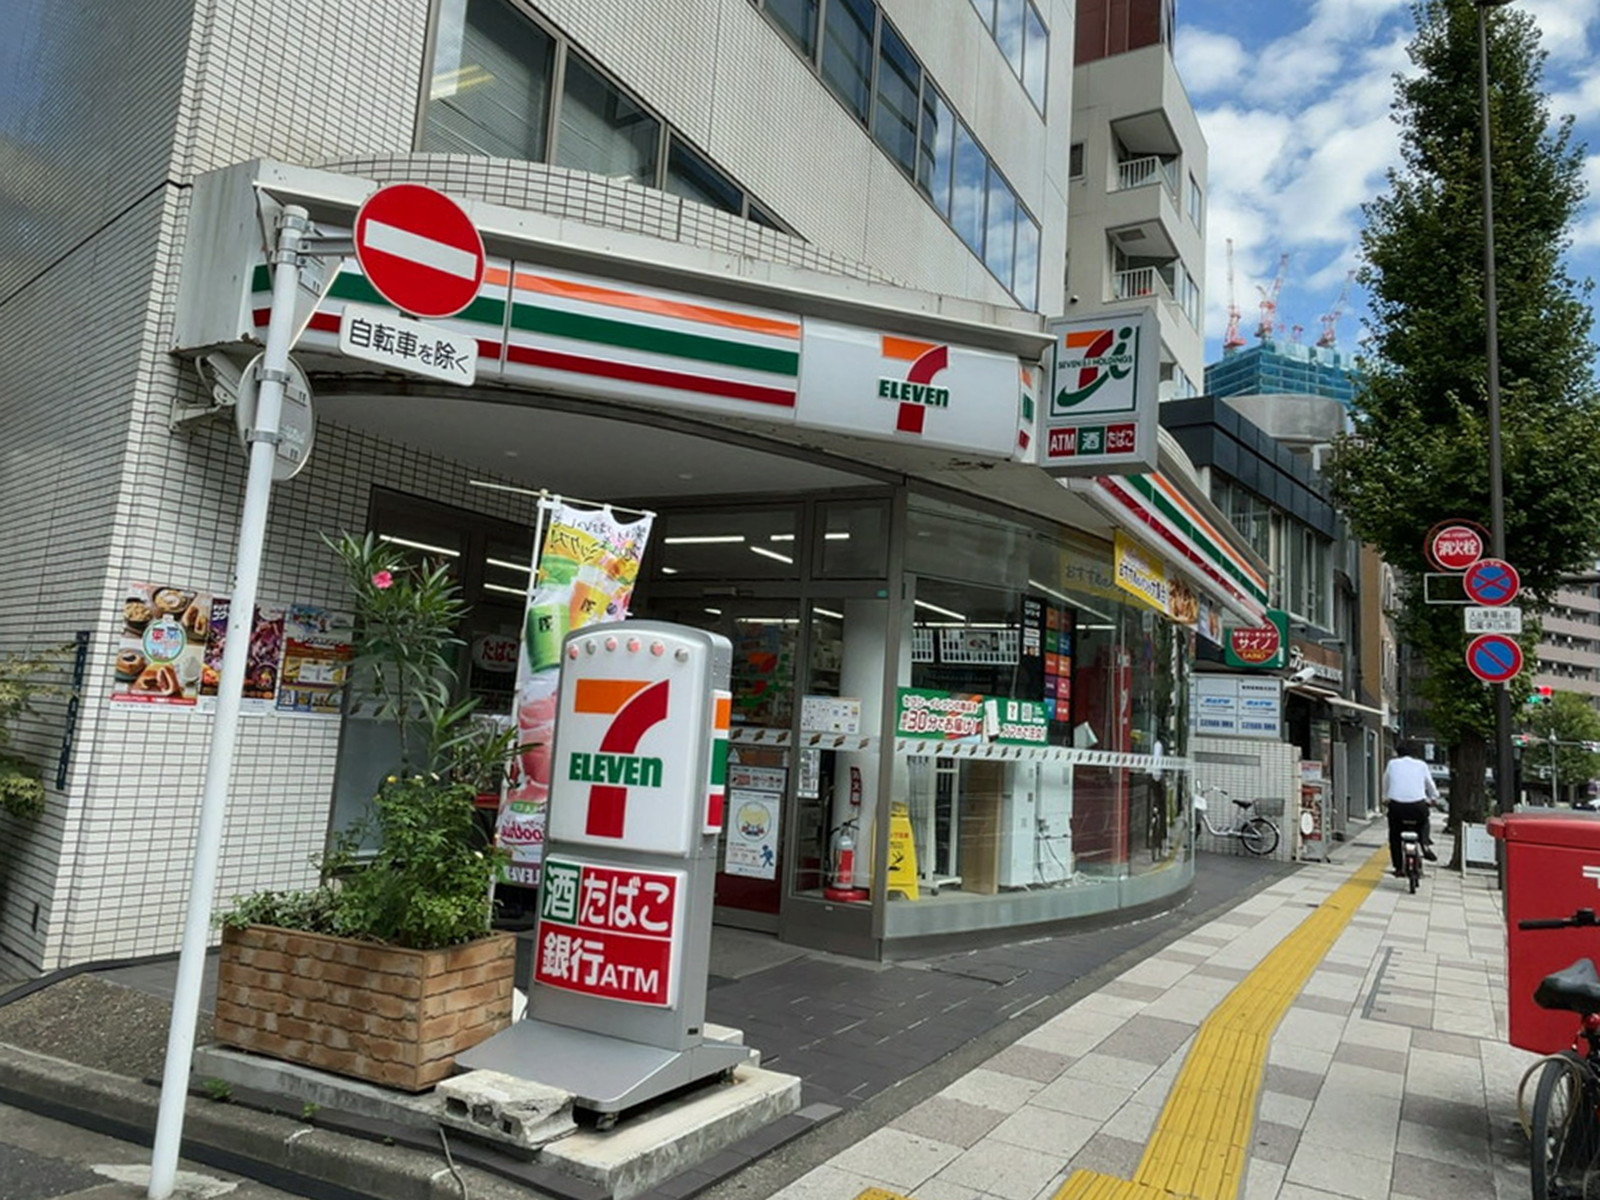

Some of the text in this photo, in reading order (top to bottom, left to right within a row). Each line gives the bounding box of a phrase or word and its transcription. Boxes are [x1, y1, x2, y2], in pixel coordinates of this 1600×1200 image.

[350, 318, 469, 374] 自転車を除く
[1050, 434, 1075, 452] ATM
[1081, 431, 1100, 450] 酒
[1107, 429, 1134, 448] たばこ
[1438, 539, 1478, 556] 消火栓
[482, 640, 517, 662] たばこ
[1238, 638, 1272, 650] サイノ
[544, 866, 579, 921] 酒
[580, 872, 669, 932] たばこ
